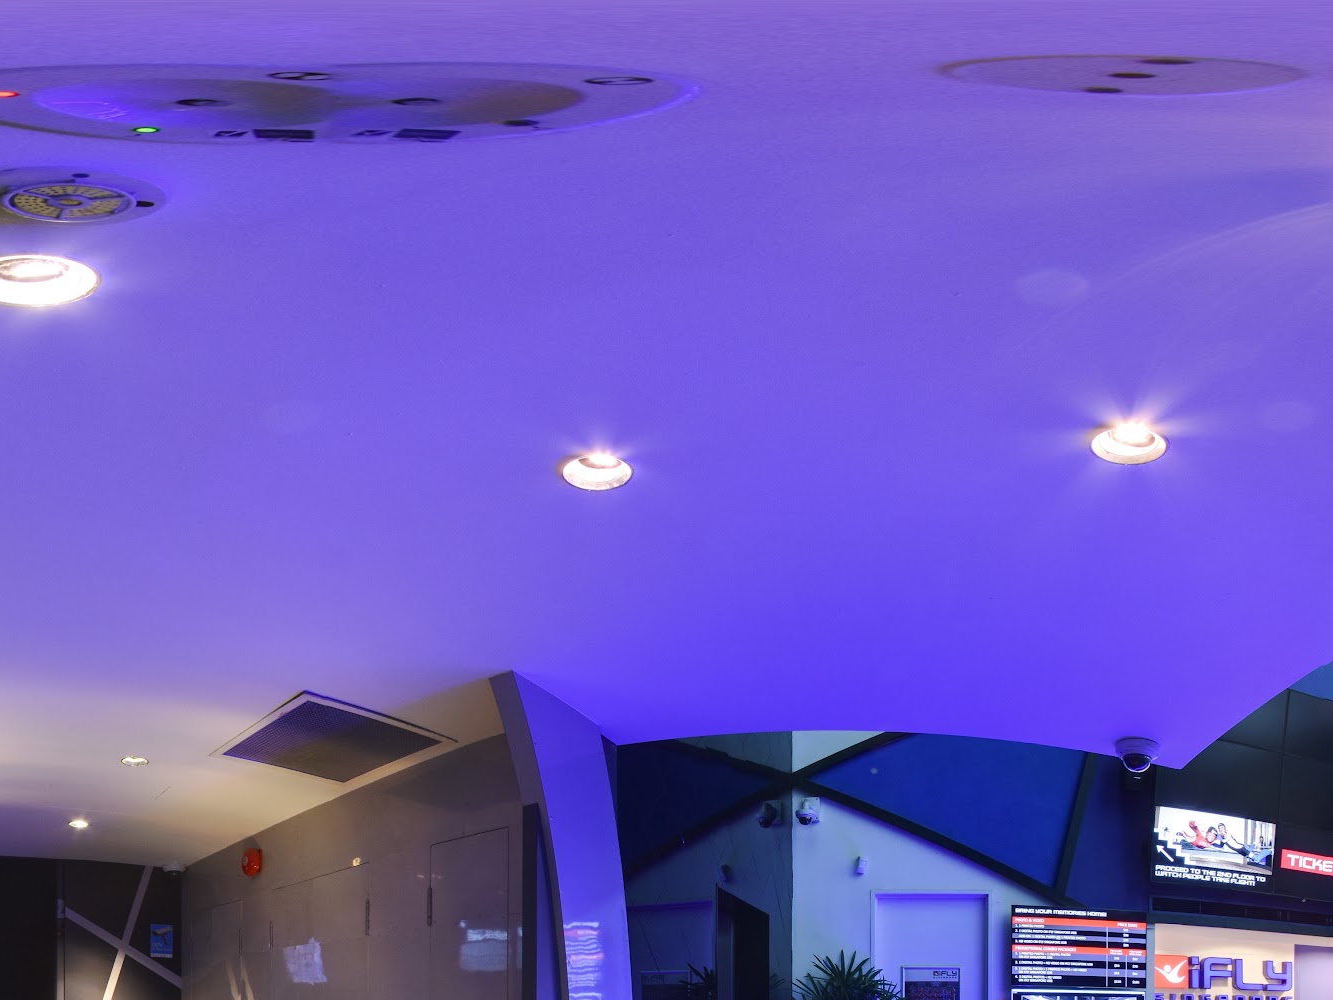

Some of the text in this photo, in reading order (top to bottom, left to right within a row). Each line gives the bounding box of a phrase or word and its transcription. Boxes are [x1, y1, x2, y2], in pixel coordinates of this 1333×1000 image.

[1287, 854, 1333, 872] TICKE
[1155, 864, 1189, 873] PROCEED
[1217, 870, 1232, 878] 2ND
[1232, 872, 1255, 880] FLOOR
[1182, 873, 1211, 881] PEOPLE
[1189, 956, 1293, 991] iFLY
